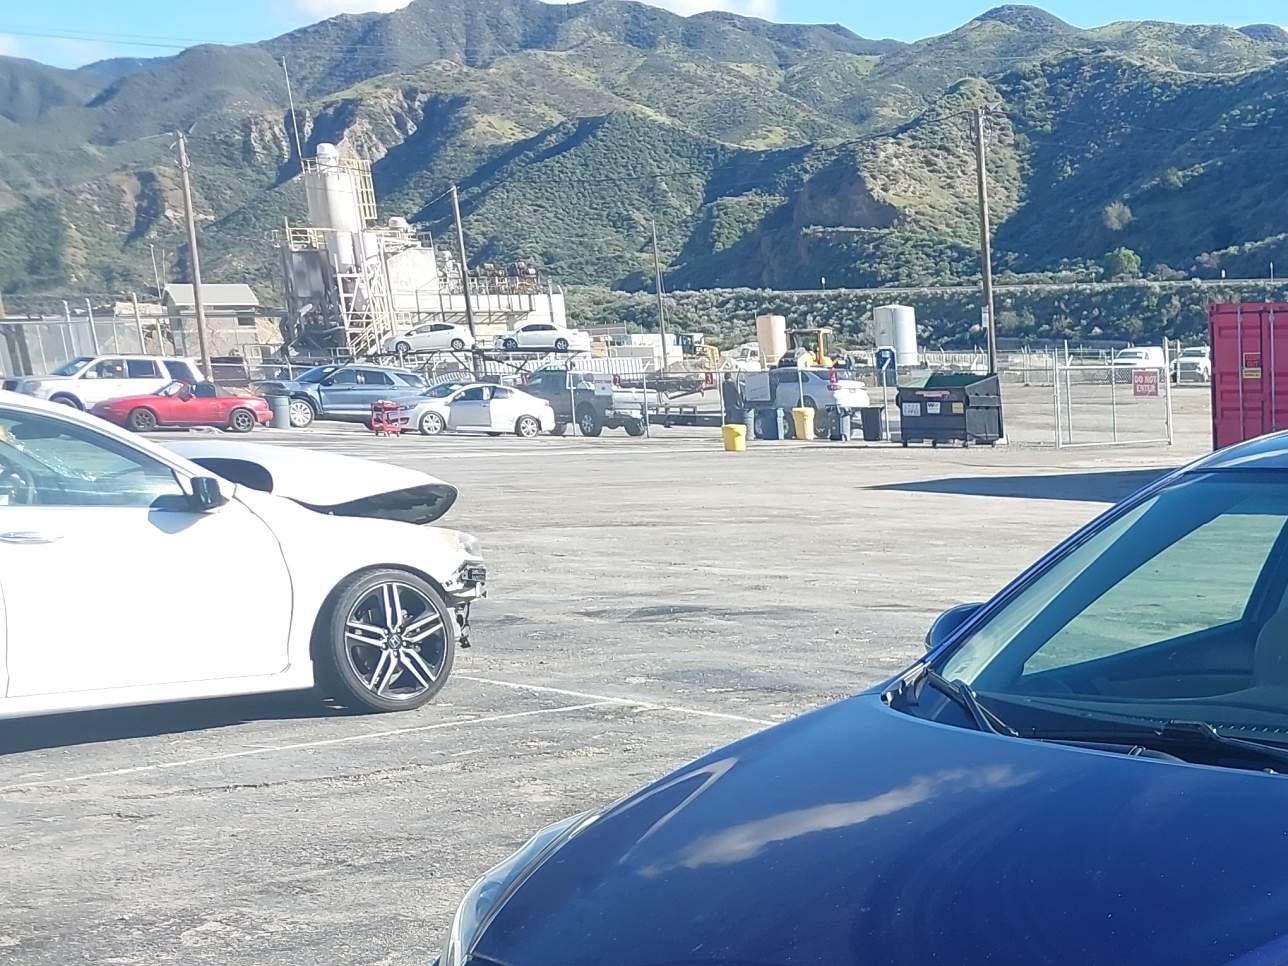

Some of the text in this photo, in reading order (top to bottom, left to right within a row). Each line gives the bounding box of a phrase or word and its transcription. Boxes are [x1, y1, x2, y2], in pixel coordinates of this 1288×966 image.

[1134, 375, 1157, 384] DO NOT
[1136, 384, 1156, 393] ENTER
